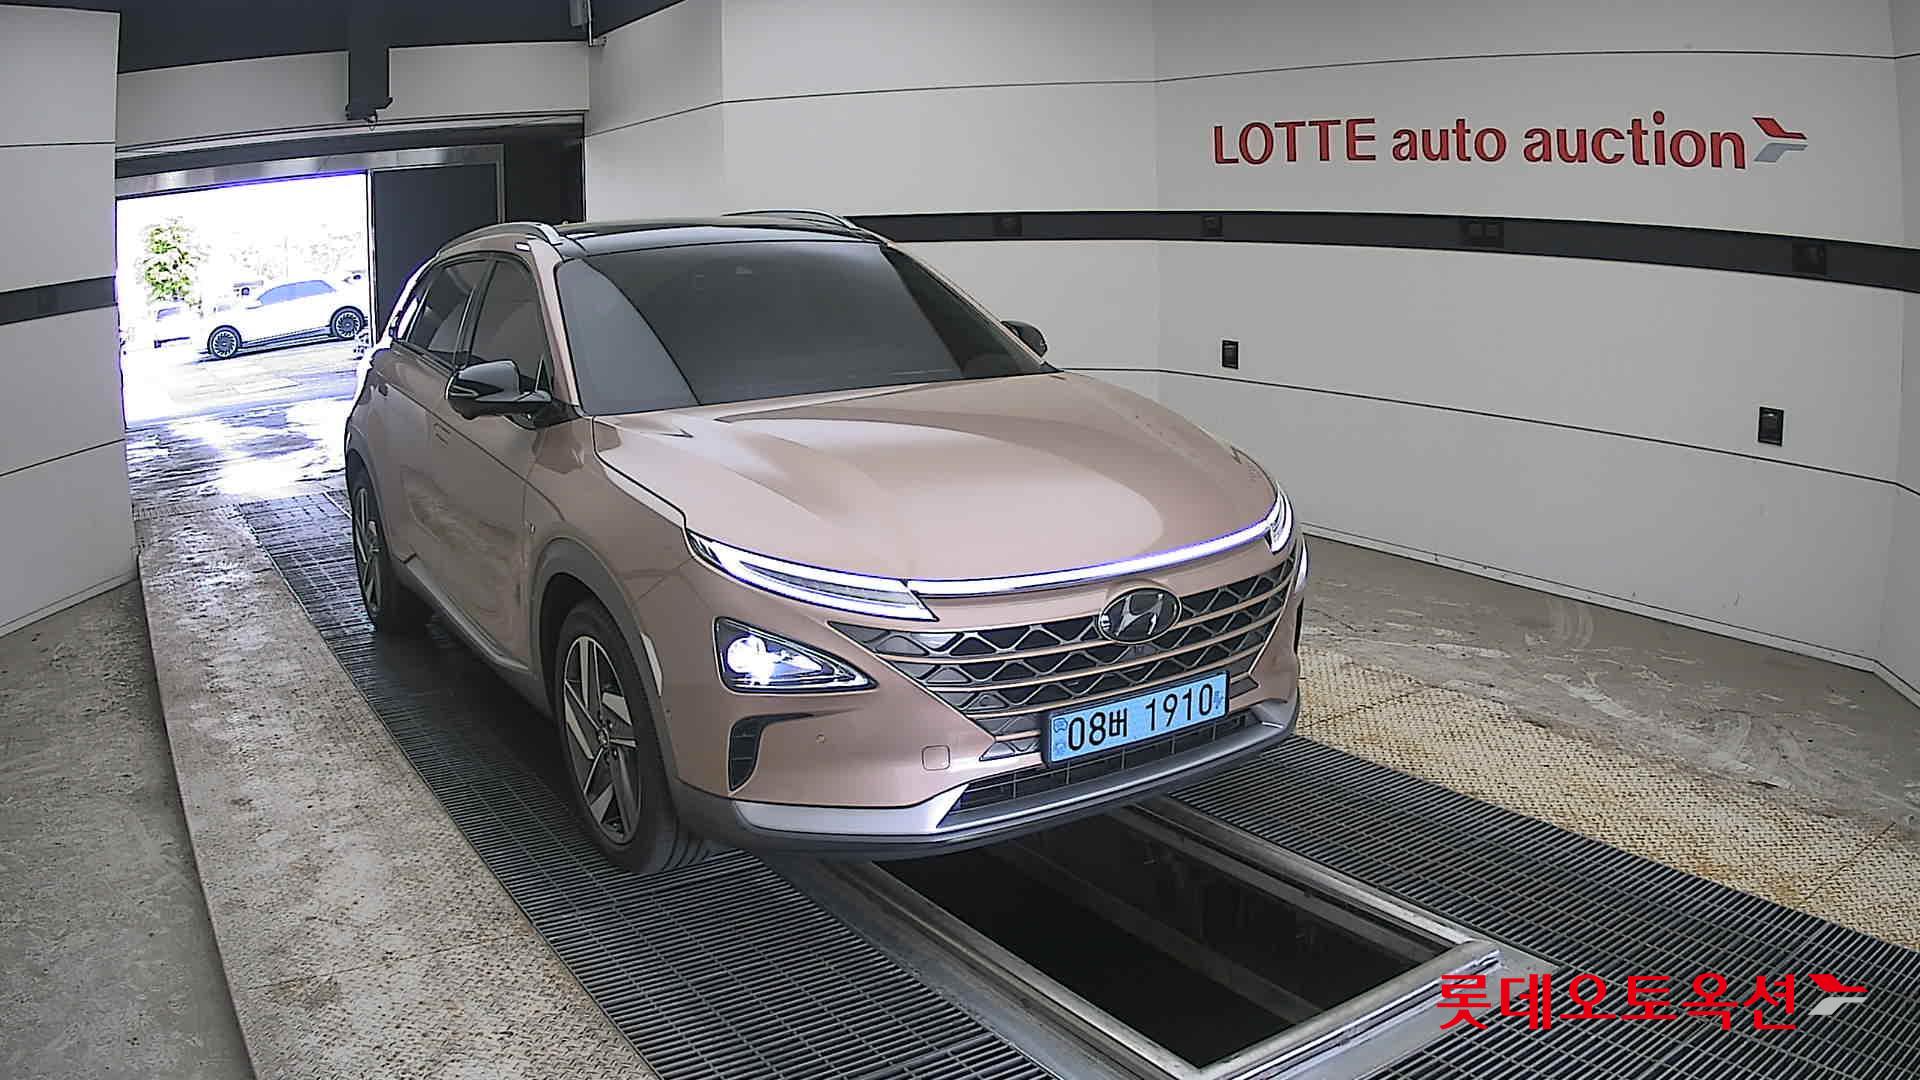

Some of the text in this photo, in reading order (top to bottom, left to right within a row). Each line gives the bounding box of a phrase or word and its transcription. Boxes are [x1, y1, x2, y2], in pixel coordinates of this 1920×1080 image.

[1213, 111, 1747, 169] LOTTE auto auction
[1068, 683, 1213, 751] 08버 1910
